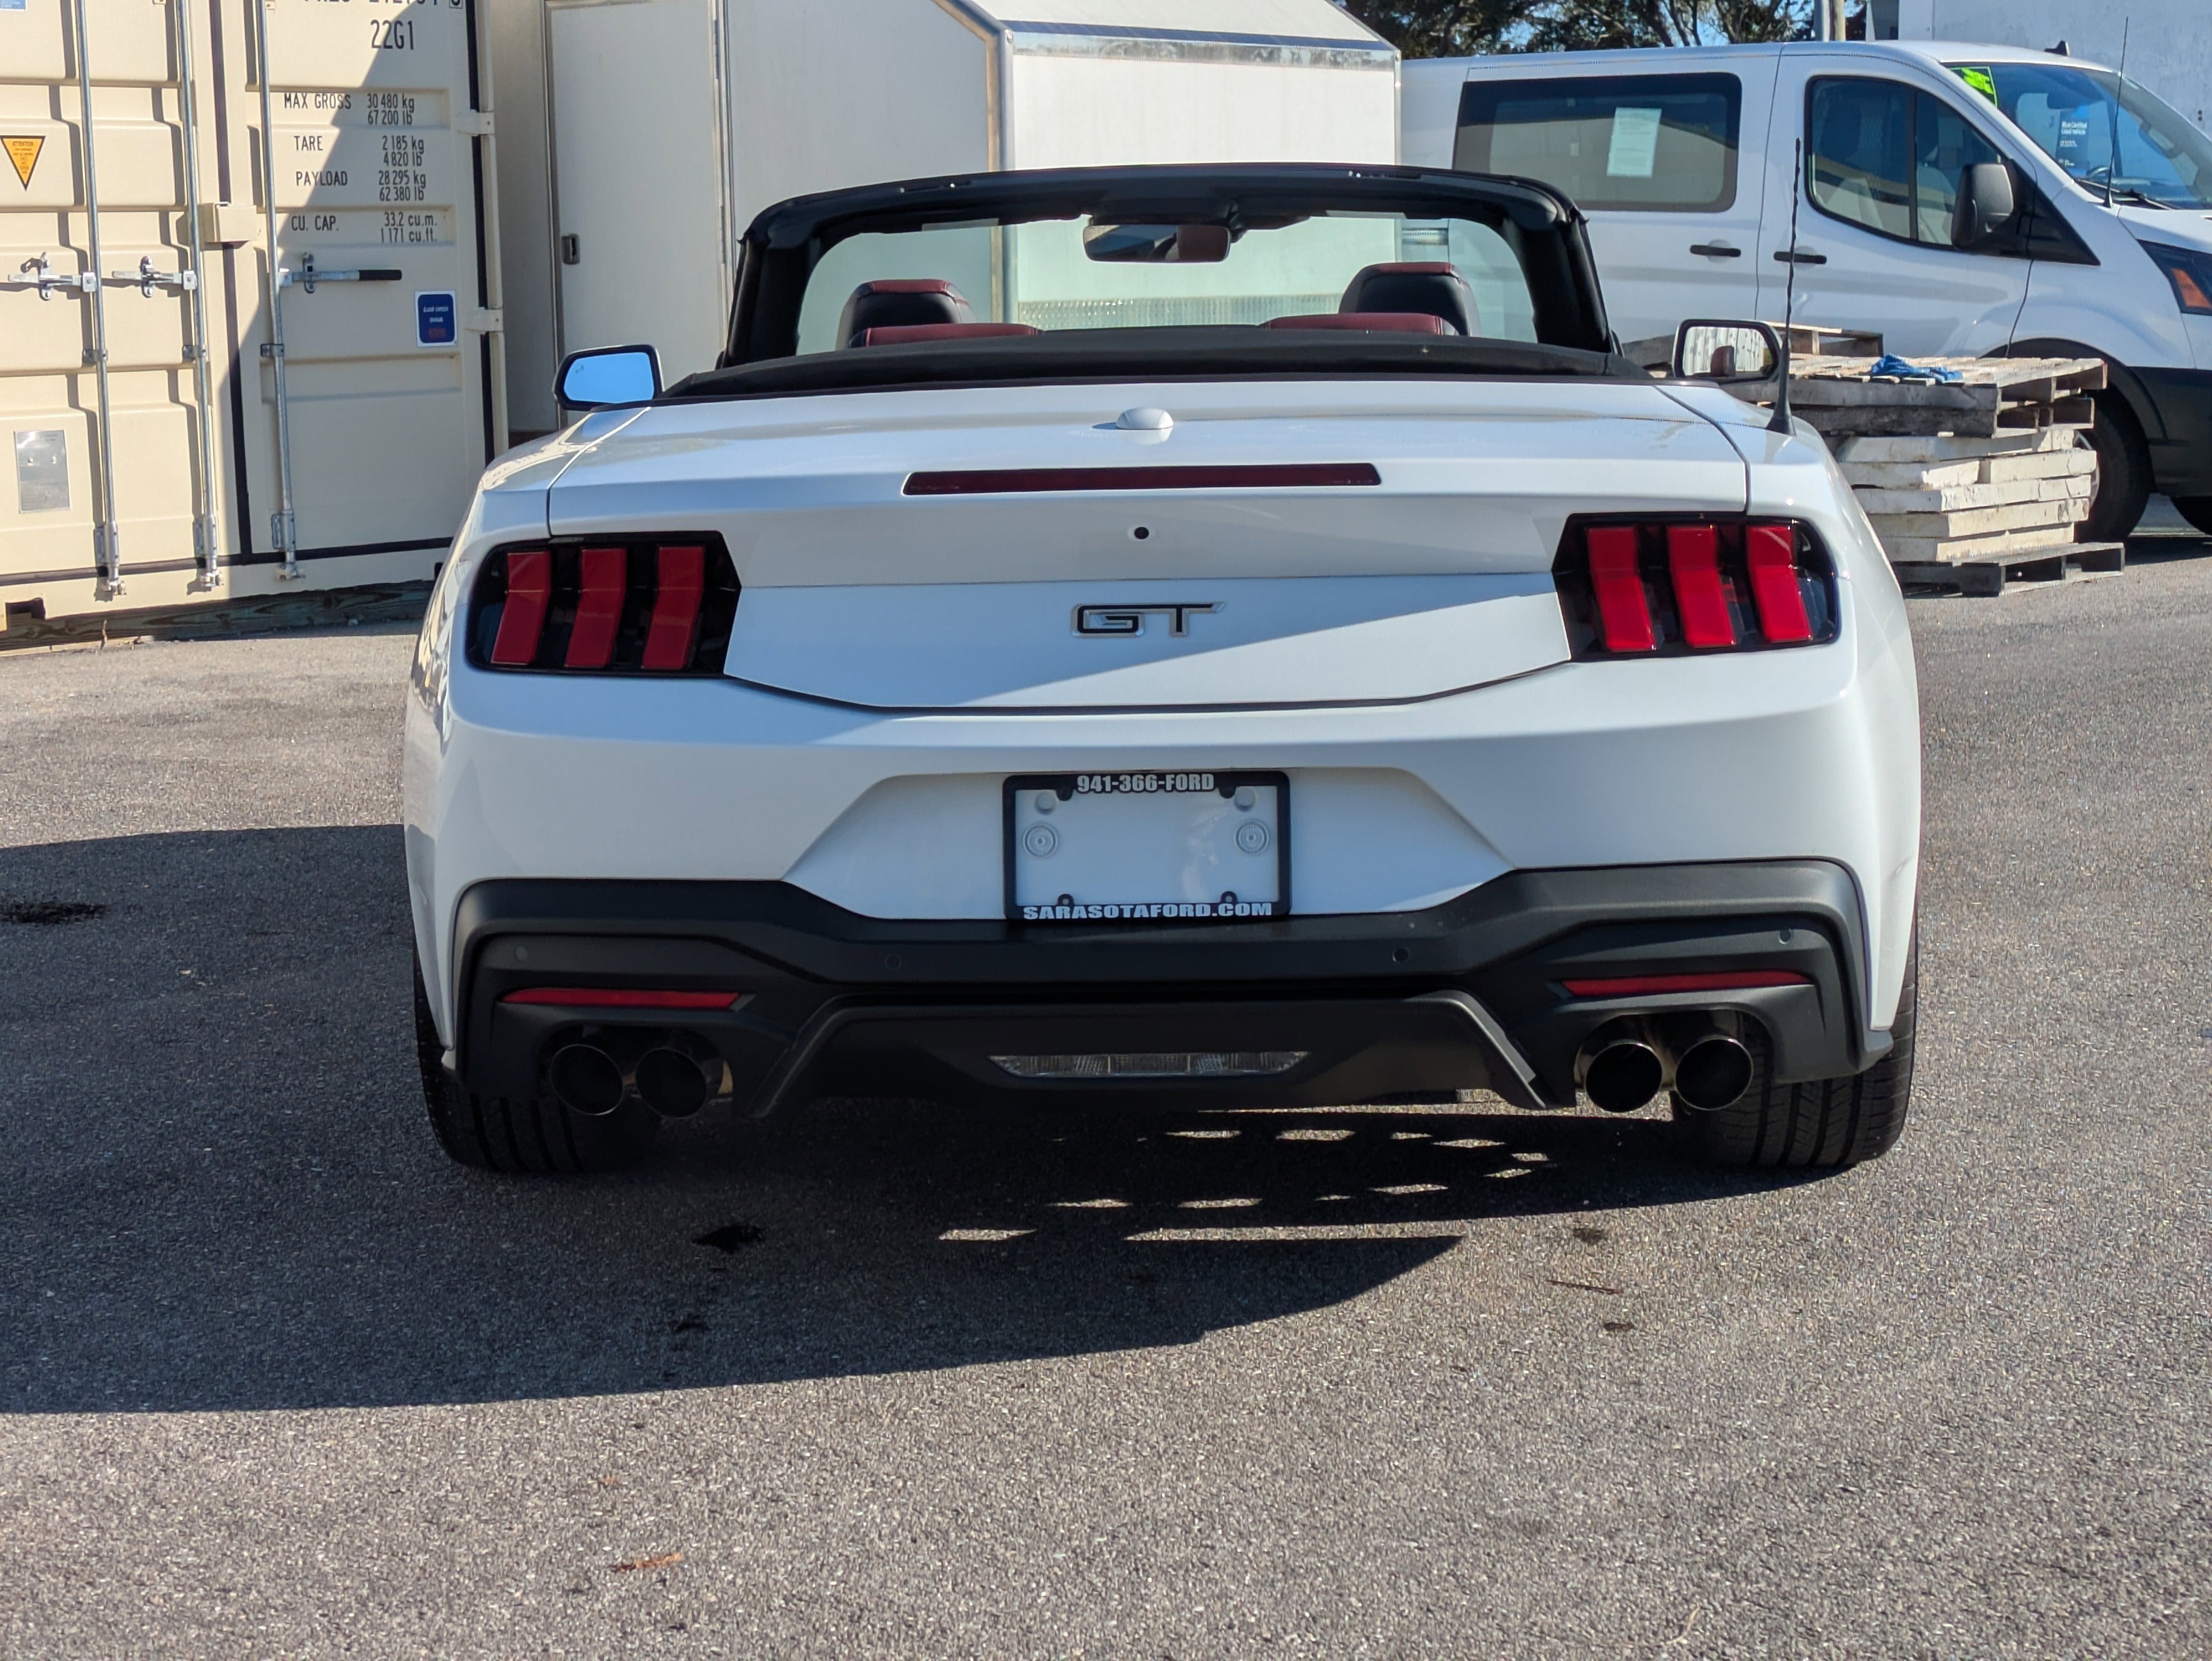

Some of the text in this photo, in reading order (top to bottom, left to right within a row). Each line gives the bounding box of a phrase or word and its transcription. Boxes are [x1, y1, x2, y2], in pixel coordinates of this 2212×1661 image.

[370, 19, 415, 50] 22G1
[284, 93, 309, 109] MAX
[314, 93, 352, 109] GROSS
[402, 94, 415, 113] kg
[294, 135, 323, 151] TARE
[411, 135, 424, 155] kg
[296, 171, 348, 186] PAYLOAD
[413, 170, 426, 189] kg
[291, 215, 309, 231] CU.
[314, 215, 339, 232] CAP.
[1071, 601, 1226, 638] GT
[1076, 774, 1215, 792] 941-366-FORD
[1023, 902, 1272, 920] SARASOTAFORD.COM
